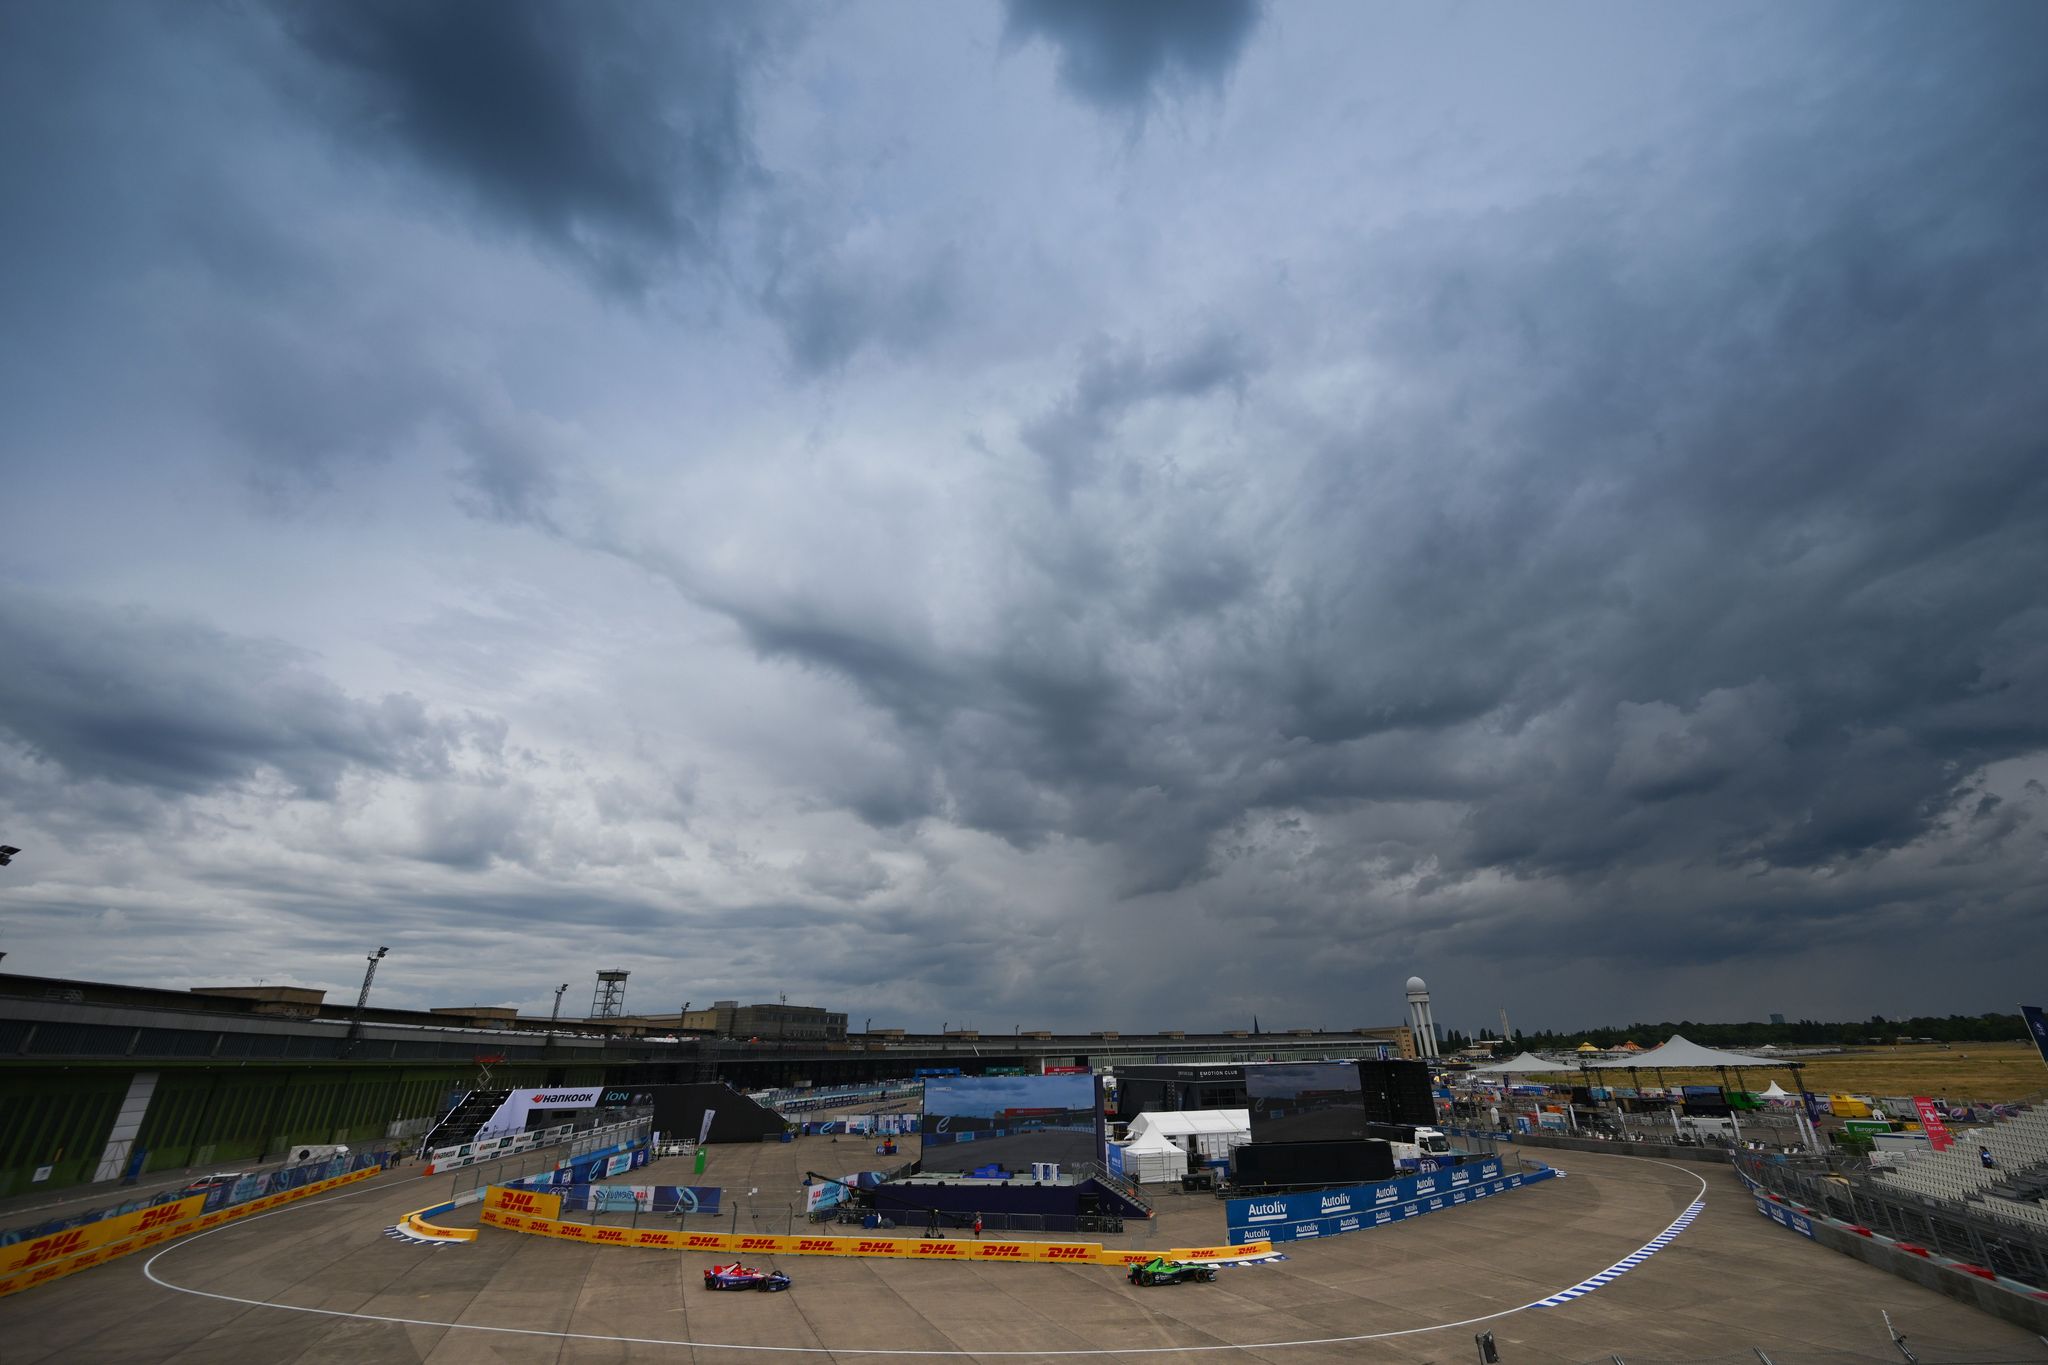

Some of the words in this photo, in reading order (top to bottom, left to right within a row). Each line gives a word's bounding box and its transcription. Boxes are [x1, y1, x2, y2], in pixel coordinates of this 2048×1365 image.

[1482, 1162, 1497, 1174] Autoliv
[1451, 1169, 1469, 1181] Autoliv
[1416, 1176, 1435, 1189] Autoliv
[1375, 1185, 1398, 1199] Autoliv
[500, 1191, 535, 1214] DHL
[1321, 1193, 1351, 1208] Autoliv
[1248, 1201, 1287, 1216] Autoliv
[136, 1203, 183, 1232] DHL
[484, 1211, 497, 1222] DHL
[504, 1216, 521, 1228] DHL
[1340, 1216, 1359, 1227] Autoliv
[530, 1221, 549, 1232] DHL
[561, 1226, 582, 1237] DHL
[1296, 1222, 1319, 1233] Autoliv
[597, 1230, 623, 1241] DHL
[640, 1233, 670, 1244] DHL
[1244, 1229, 1271, 1239] Autoliv
[688, 1236, 721, 1247] DHL
[741, 1238, 776, 1249] DHL
[799, 1240, 835, 1251] DHL
[21, 1230, 85, 1267] DHL
[858, 1242, 896, 1253] DHL
[920, 1243, 957, 1255] DHL
[982, 1245, 1022, 1257] DHL
[1047, 1247, 1089, 1258] DHL
[1237, 1246, 1259, 1255] DHL
[1191, 1250, 1217, 1258] DHL
